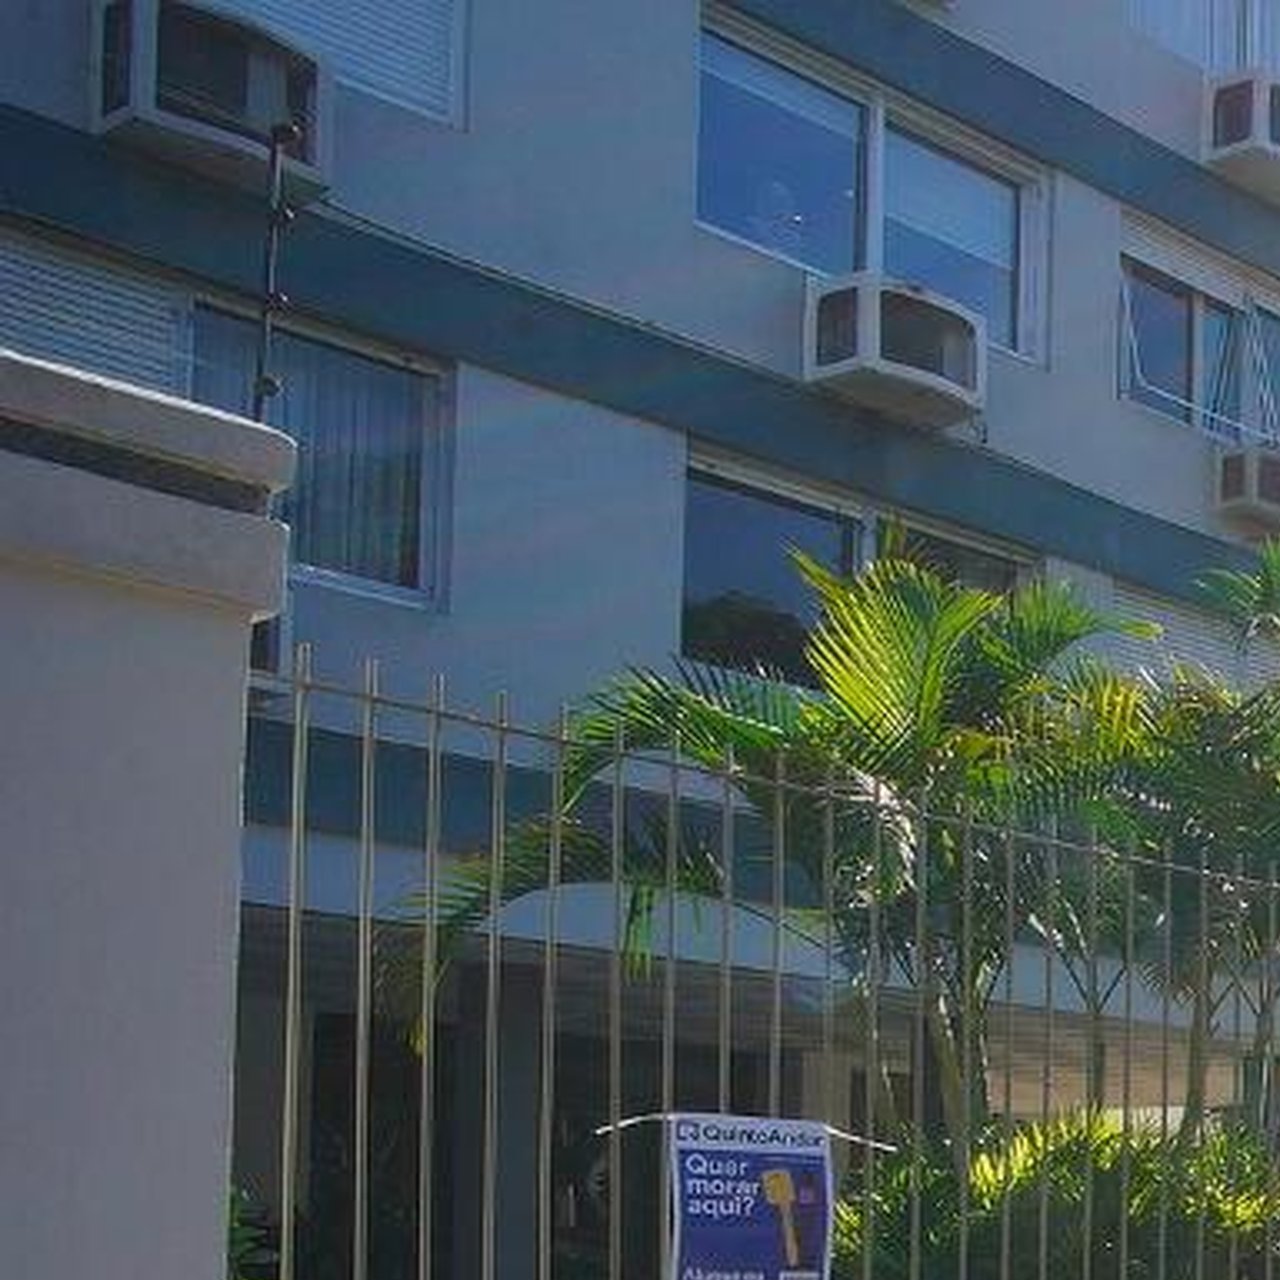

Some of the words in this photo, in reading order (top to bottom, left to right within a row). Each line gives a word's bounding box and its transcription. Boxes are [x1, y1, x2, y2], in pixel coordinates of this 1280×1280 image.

[703, 1124, 825, 1147] QuintoAndar
[685, 1153, 748, 1176] Quer
[687, 1178, 761, 1195] morar
[687, 1196, 755, 1218] aqui?
